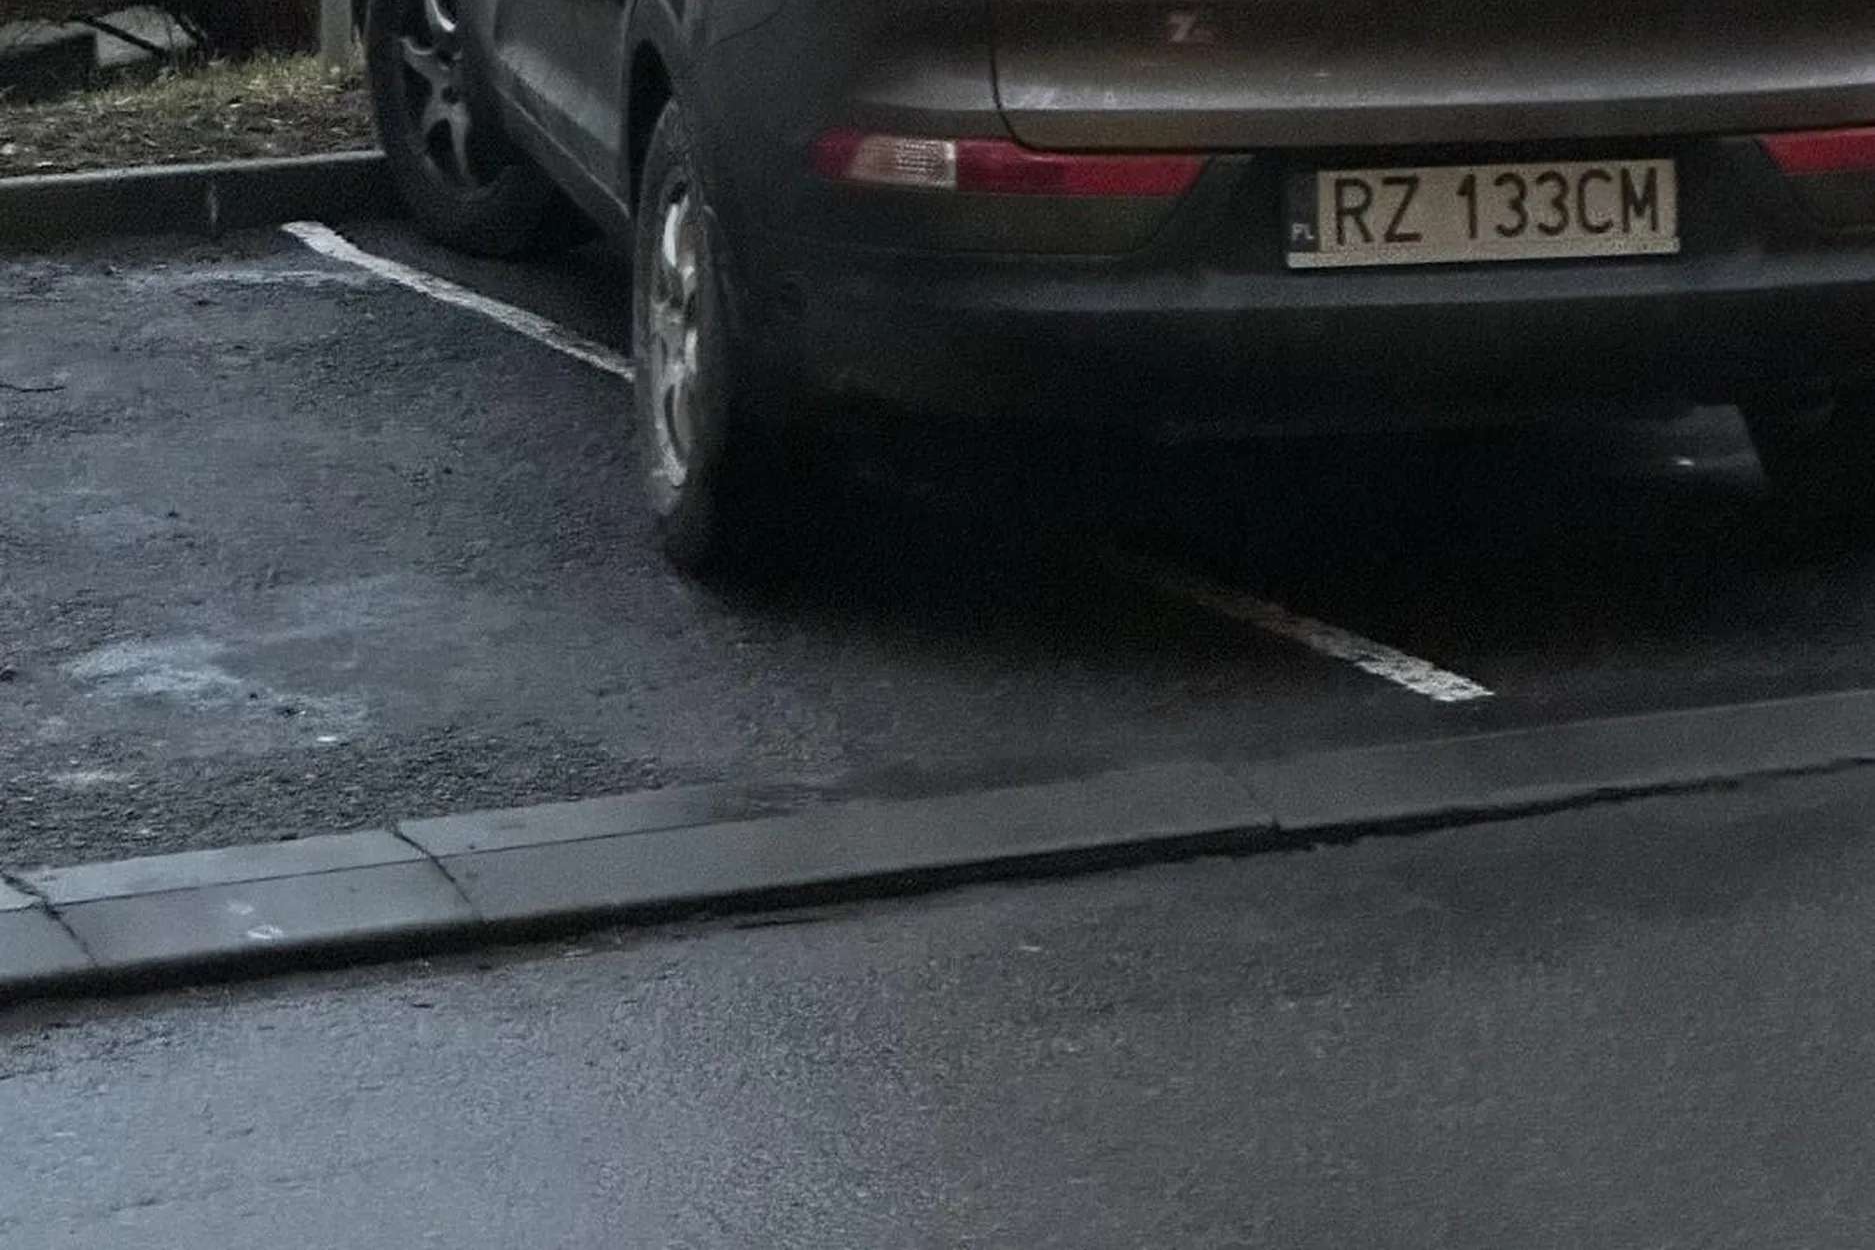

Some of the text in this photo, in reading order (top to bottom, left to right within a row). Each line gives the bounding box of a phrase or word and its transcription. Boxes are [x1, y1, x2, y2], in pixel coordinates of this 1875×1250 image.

[1291, 221, 1315, 242] PL
[1334, 166, 1660, 247] RZ 133CM
